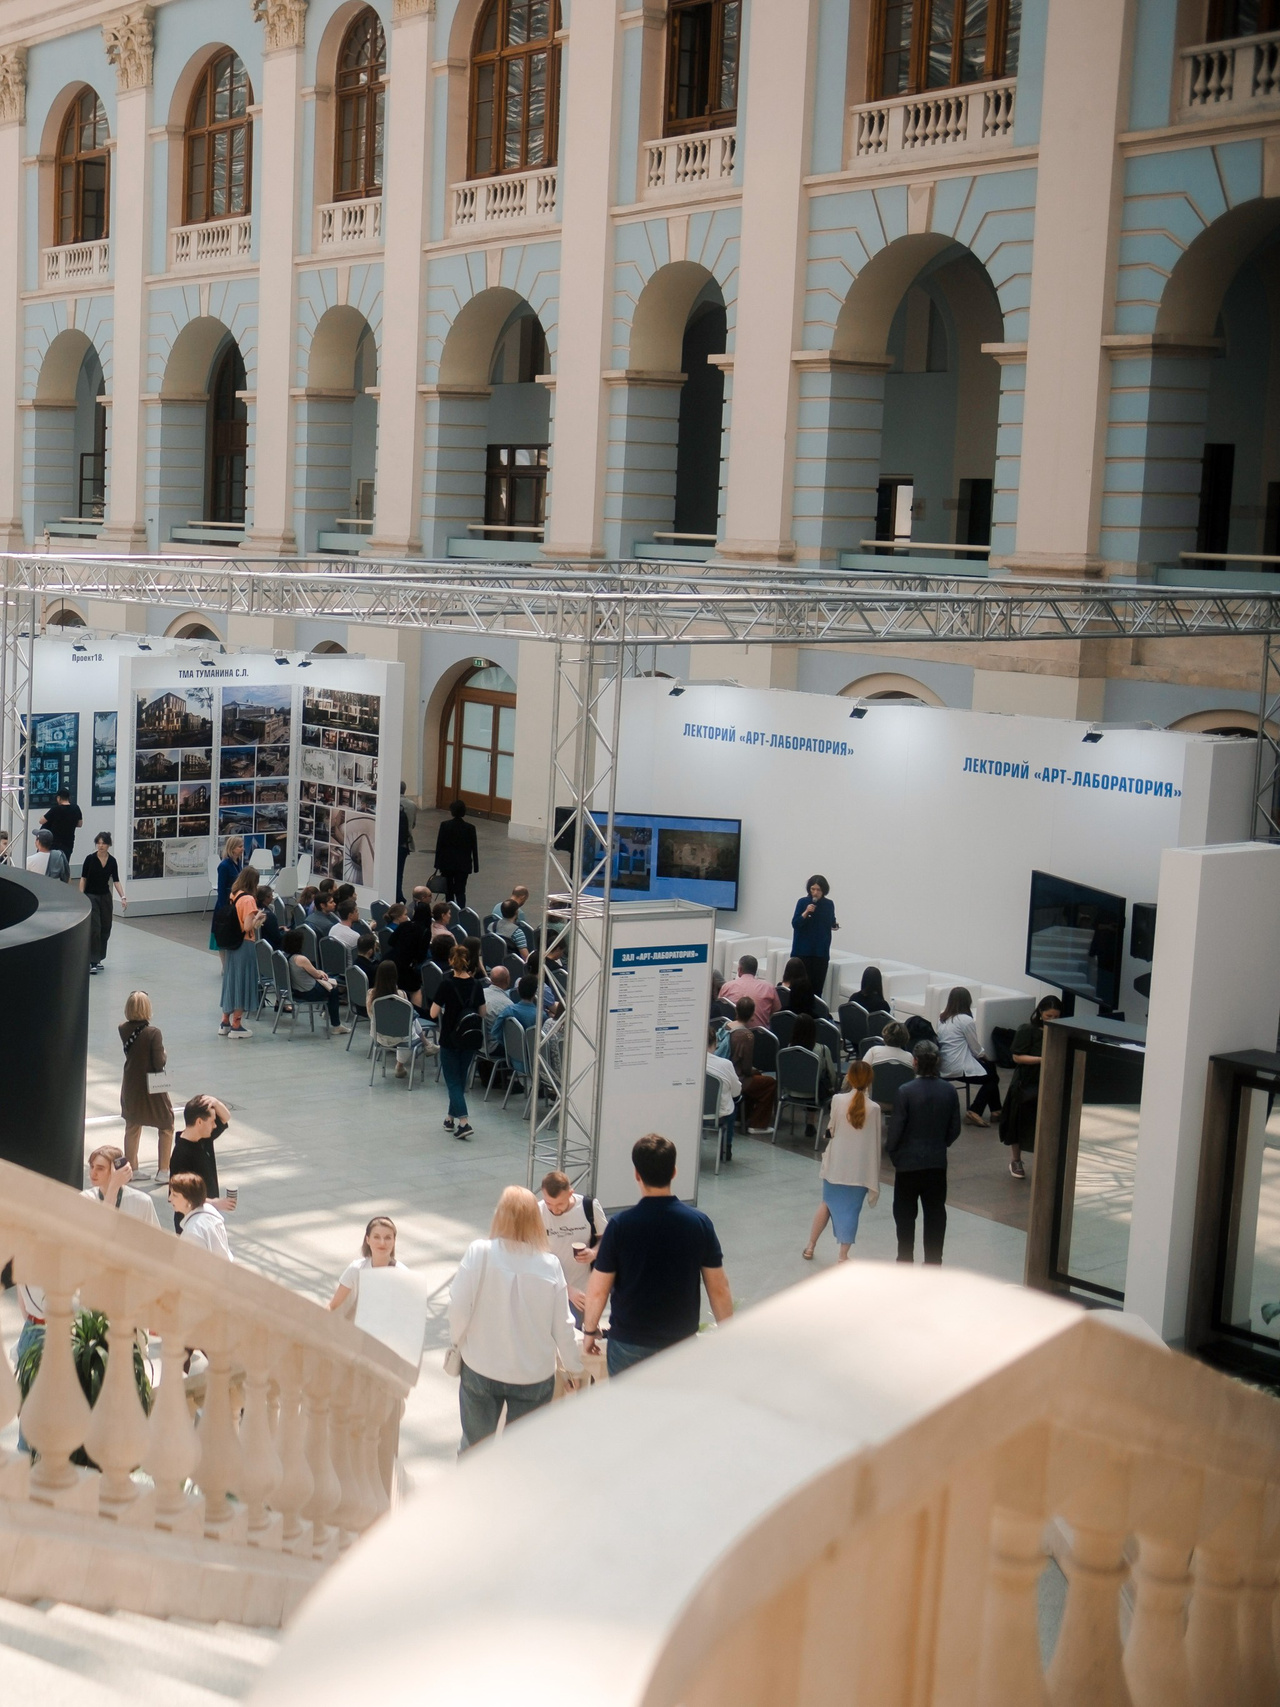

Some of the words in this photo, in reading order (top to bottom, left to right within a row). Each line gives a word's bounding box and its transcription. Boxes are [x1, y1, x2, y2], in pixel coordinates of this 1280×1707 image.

[179, 670, 194, 678] ТМА
[196, 669, 233, 678] ТУМАНИНА
[683, 723, 736, 743] ЛЕКТОРИЙ
[739, 731, 854, 756] «АРТ-ЛАБОРАТОРИЯ»
[963, 757, 1030, 780] ЛЕКТОРИЙ
[1034, 767, 1182, 798] «АРТ-ЛАБОРАТОРИЯ»
[621, 953, 635, 962] ЗАЛ
